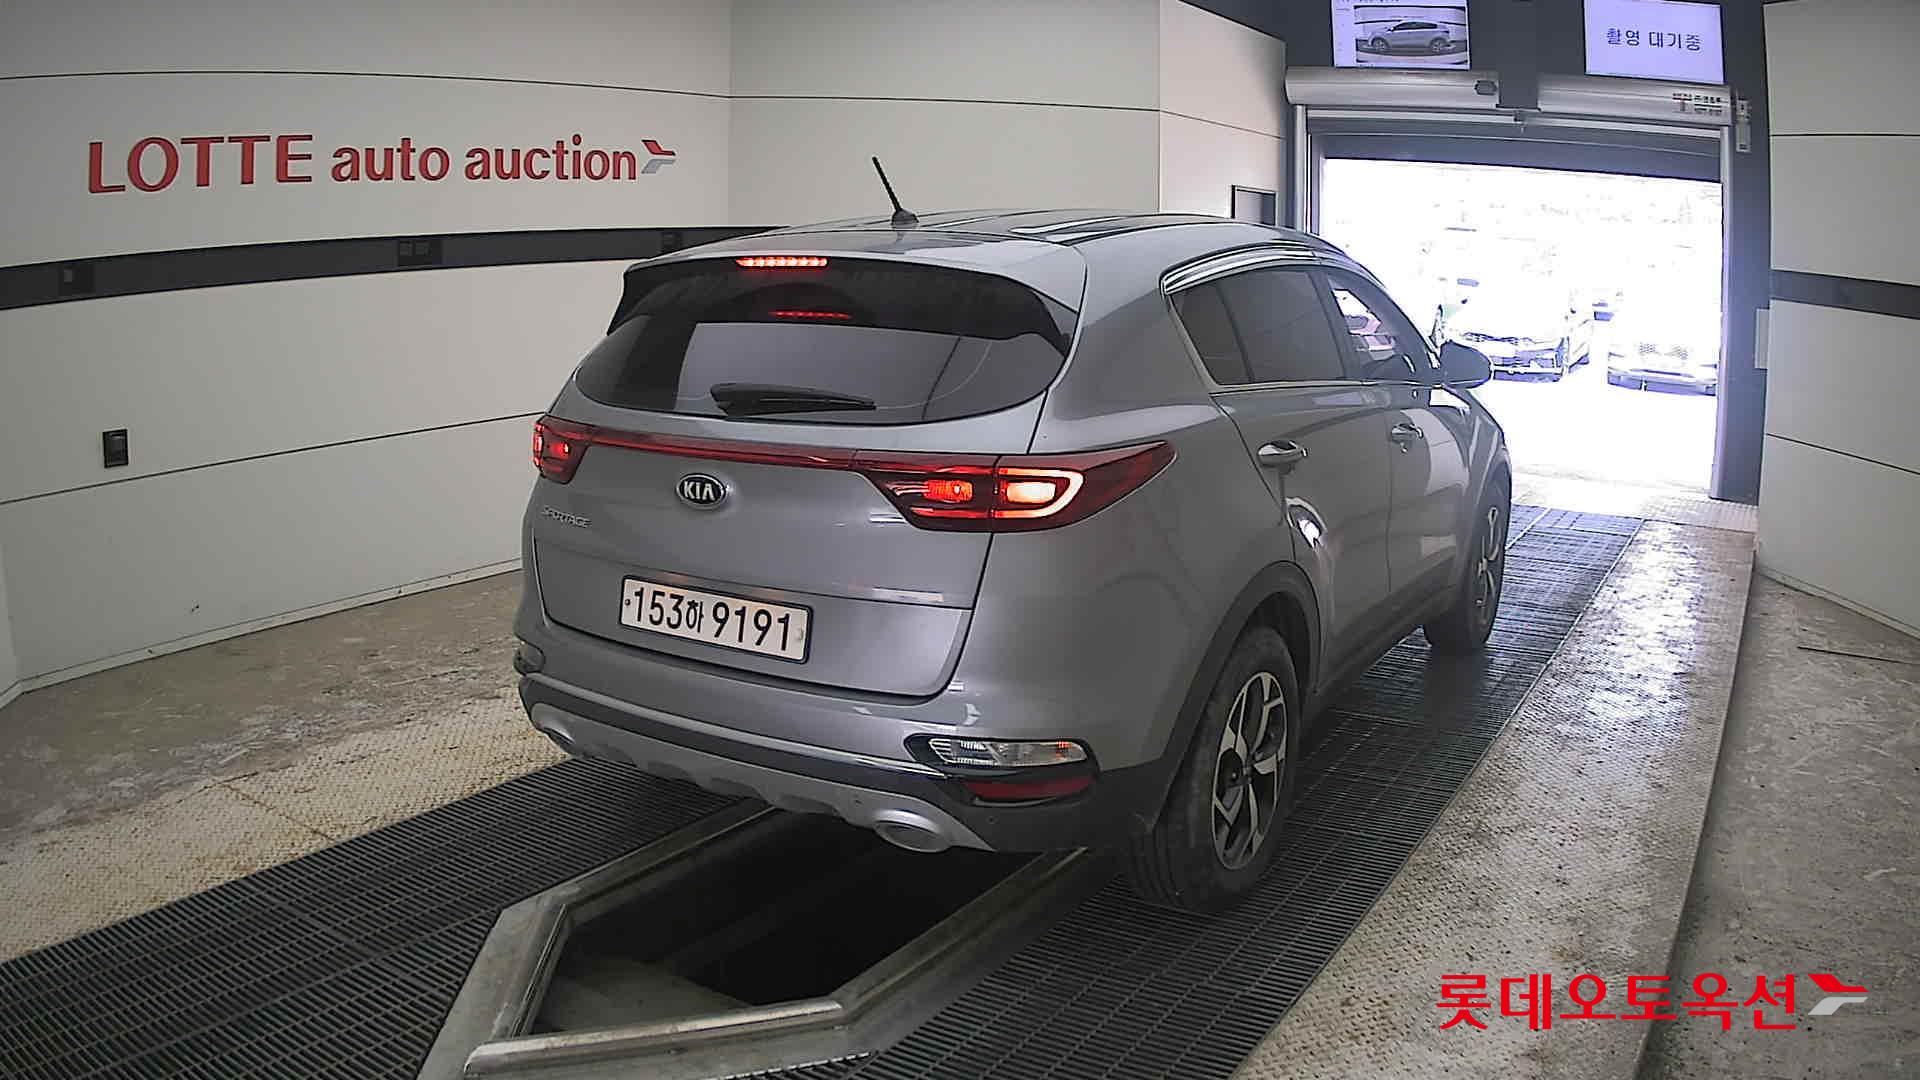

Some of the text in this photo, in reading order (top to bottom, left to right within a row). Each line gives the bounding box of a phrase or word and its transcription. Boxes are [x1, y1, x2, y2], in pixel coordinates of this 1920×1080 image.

[1607, 28, 1640, 46] 촬영
[88, 133, 638, 194] LOTTE auto auction
[683, 481, 716, 501] KIA
[541, 505, 592, 528] SPORTAGE
[634, 586, 791, 651] 153하 9191
